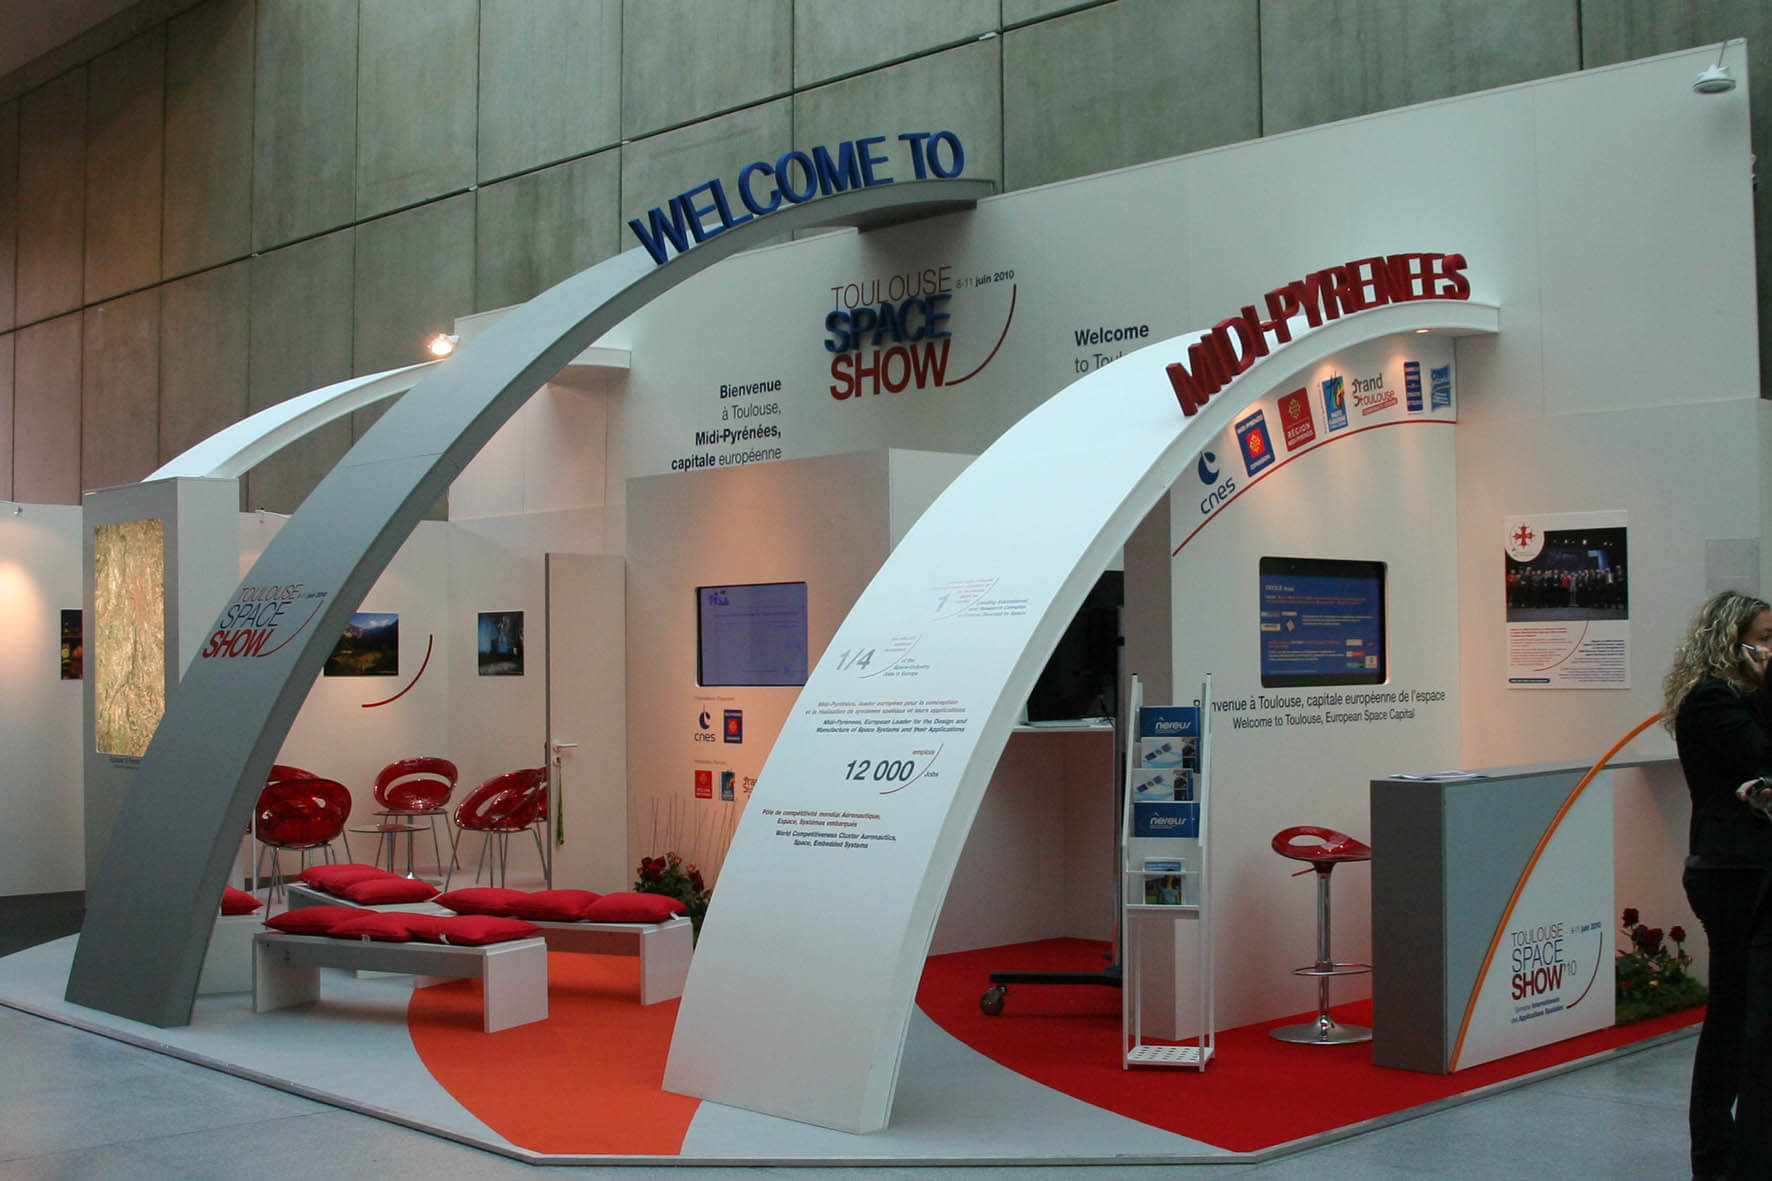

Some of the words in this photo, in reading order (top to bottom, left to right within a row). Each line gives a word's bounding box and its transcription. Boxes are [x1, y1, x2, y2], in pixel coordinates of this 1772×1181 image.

[628, 136, 894, 265] WELCOME
[898, 130, 965, 180] TO
[831, 266, 952, 310] TOULOUSE
[976, 274, 991, 288] juin
[993, 270, 1015, 282] 2010
[824, 294, 952, 353] SPACE
[1074, 325, 1149, 346] Welcome
[830, 339, 951, 400] SHOW
[1075, 357, 1088, 373] to
[720, 379, 782, 399] Bienvenue
[722, 406, 728, 421] à
[731, 402, 781, 419] Toulouse,
[695, 424, 781, 446] Midi-Pyrénées,
[671, 453, 715, 472] capitale
[719, 448, 782, 465] européenne
[1201, 477, 1235, 514] cnes
[220, 601, 293, 629] SPACE
[202, 629, 274, 658] SHOW
[836, 648, 876, 671] 1/4
[1250, 697, 1256, 710] à
[1258, 696, 1304, 711] Toulouse,
[1306, 693, 1343, 708] capitale
[1345, 691, 1396, 706] européenne
[1399, 690, 1409, 702] de
[1233, 716, 1272, 729] Welcome
[1275, 716, 1283, 726] to
[1285, 713, 1323, 727] Toulouse,
[1326, 711, 1362, 725] European
[1364, 709, 1388, 723] Space
[694, 733, 716, 742] cnes
[845, 760, 870, 780] 12
[873, 760, 915, 781] 000
[1512, 922, 1563, 947] TOULOUSE
[1512, 939, 1563, 973] SPACE
[1512, 963, 1563, 1001] SHOW
